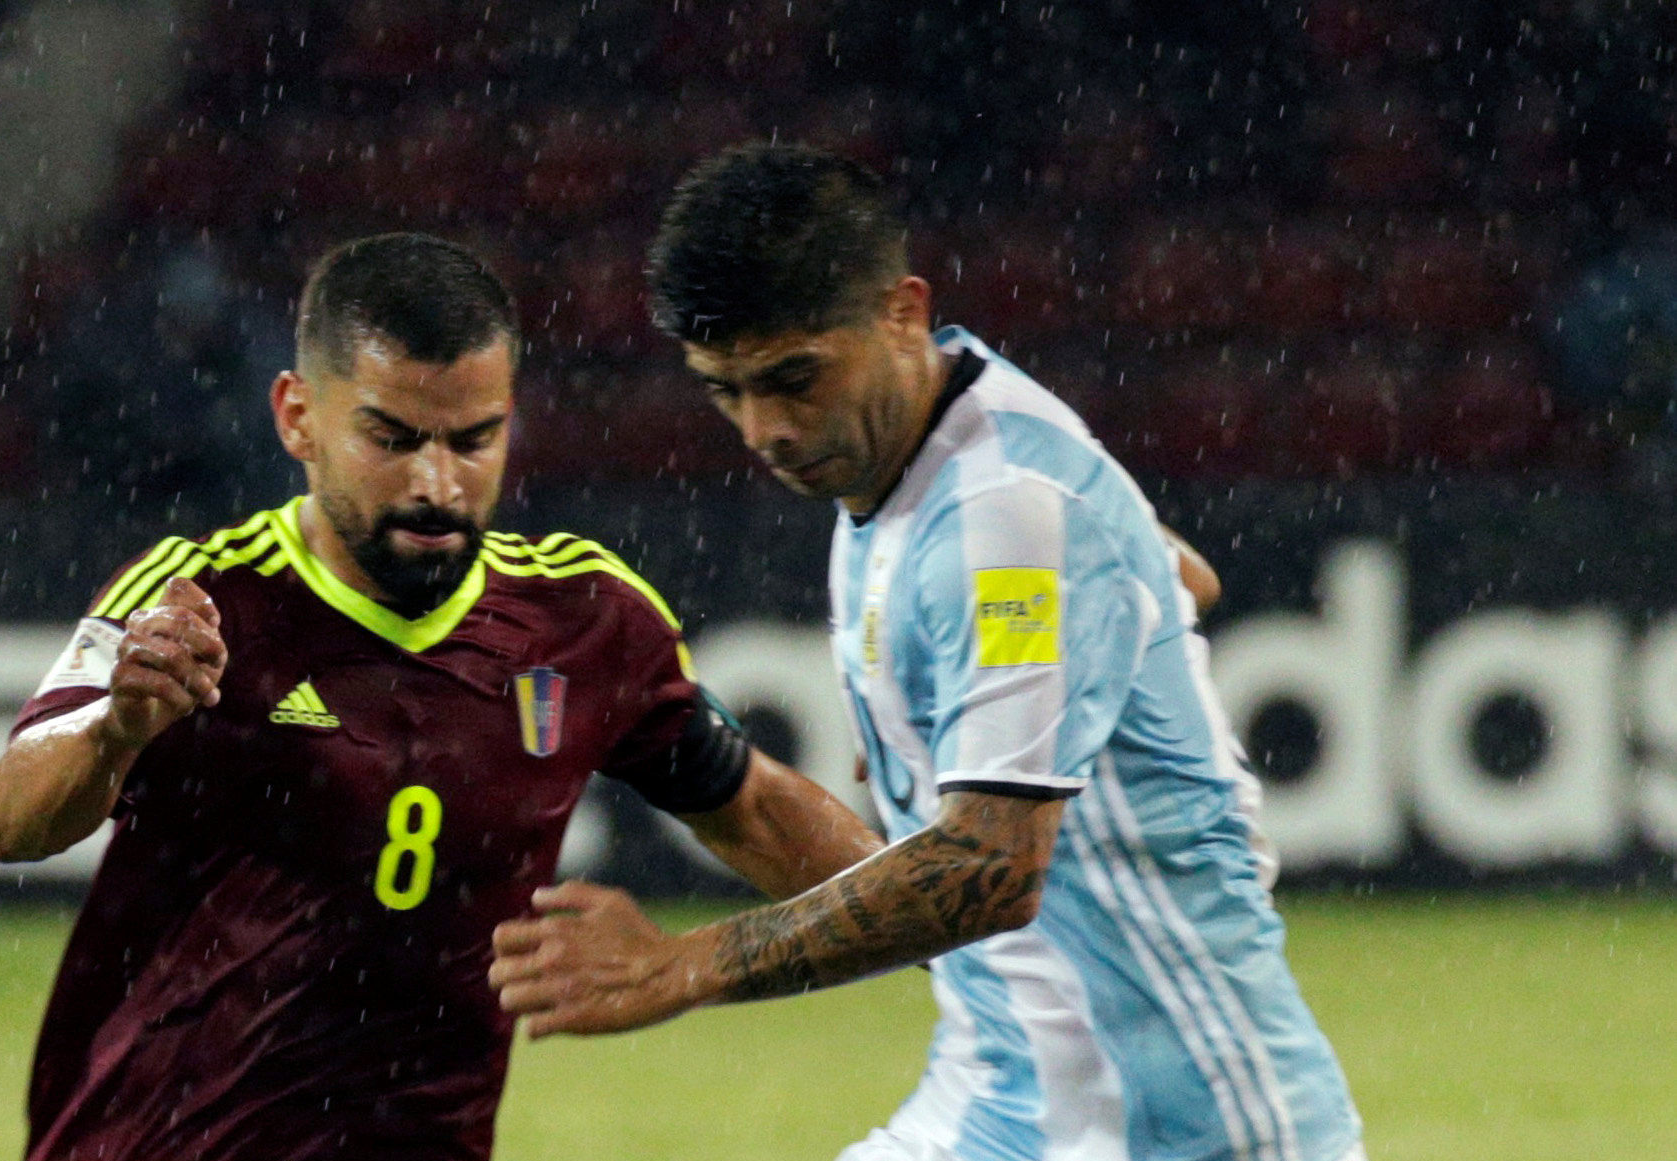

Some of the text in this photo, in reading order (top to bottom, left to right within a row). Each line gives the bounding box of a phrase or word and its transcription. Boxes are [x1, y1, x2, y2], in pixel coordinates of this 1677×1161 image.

[979, 600, 1028, 619] FIFA
[268, 711, 341, 728] adidas
[373, 785, 442, 911] 8
